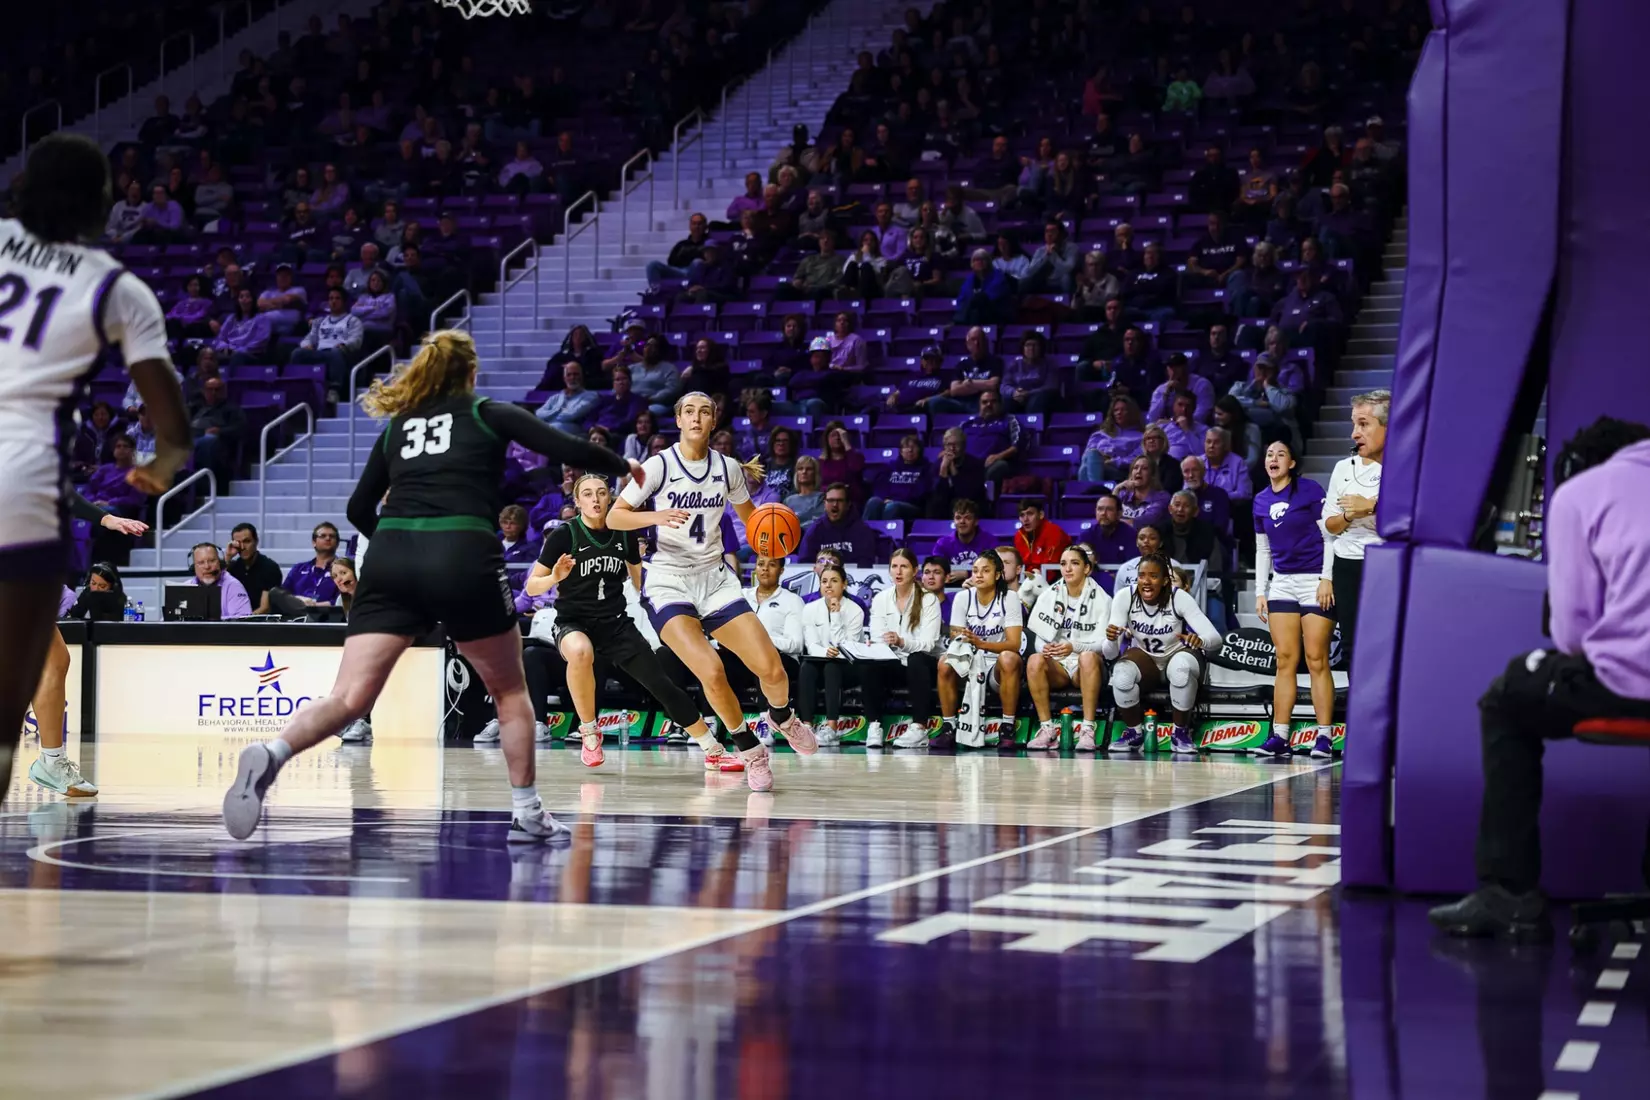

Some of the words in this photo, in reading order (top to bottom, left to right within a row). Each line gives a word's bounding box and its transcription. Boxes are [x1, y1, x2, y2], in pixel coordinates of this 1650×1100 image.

[0, 272, 64, 350] 21
[400, 412, 453, 460] 33
[667, 491, 724, 509] Wildcats
[688, 513, 706, 544] 4
[951, 550, 979, 565] K-STA
[597, 577, 606, 600] 1
[1130, 620, 1174, 636] Wildcats
[1142, 637, 1165, 654] 12
[1219, 645, 1272, 669] Federal
[198, 694, 314, 717] FREED
[197, 718, 251, 726] BEHAVIORAL
[1201, 721, 1257, 746] LIBMAN
[1290, 725, 1345, 747] LIBN
